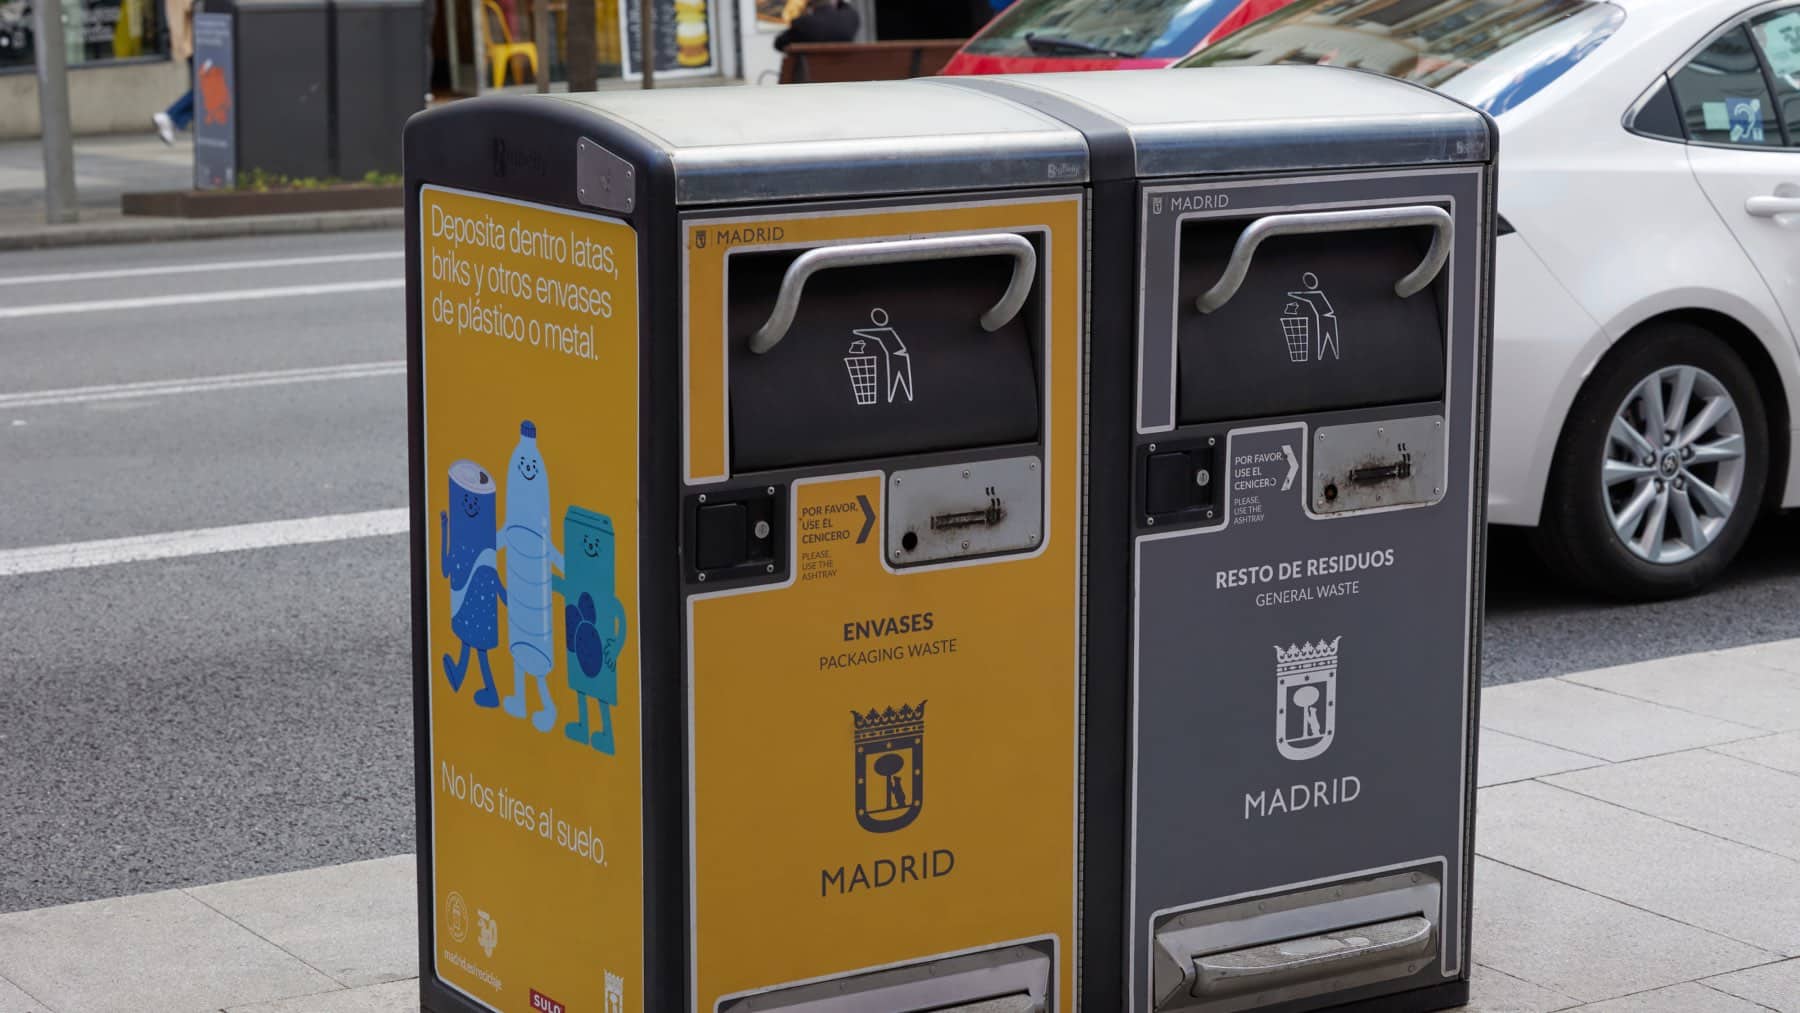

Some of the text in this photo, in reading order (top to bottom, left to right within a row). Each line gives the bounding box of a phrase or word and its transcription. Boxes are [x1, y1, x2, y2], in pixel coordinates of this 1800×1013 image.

[1171, 194, 1229, 212] MADRID
[431, 204, 619, 280] Deposita dentro latas,
[717, 226, 785, 245] MADRID
[432, 247, 613, 319] briks y otros envases
[432, 290, 599, 361] de plástico o metal.
[1234, 455, 1253, 465] POR
[1234, 466, 1262, 478] USE EL
[1234, 477, 1277, 490] CENICERO
[802, 506, 822, 517] POR
[1233, 513, 1265, 525] ASHTRAY
[1234, 504, 1262, 516] USE THE
[802, 518, 833, 530] USE EL
[802, 530, 850, 544] CENICERO
[802, 559, 833, 571] USE THE
[1216, 549, 1394, 589] RESTO DE RESIDUOS
[802, 569, 838, 581] ASHTRAY
[1255, 580, 1360, 607] GENERAL WASTE
[843, 612, 934, 641] ENVASES
[819, 638, 957, 671] PACKAGING WASTE
[1245, 775, 1361, 820] MADRID
[441, 760, 608, 867] No los tires al suelo.
[821, 848, 955, 897] MADRID
